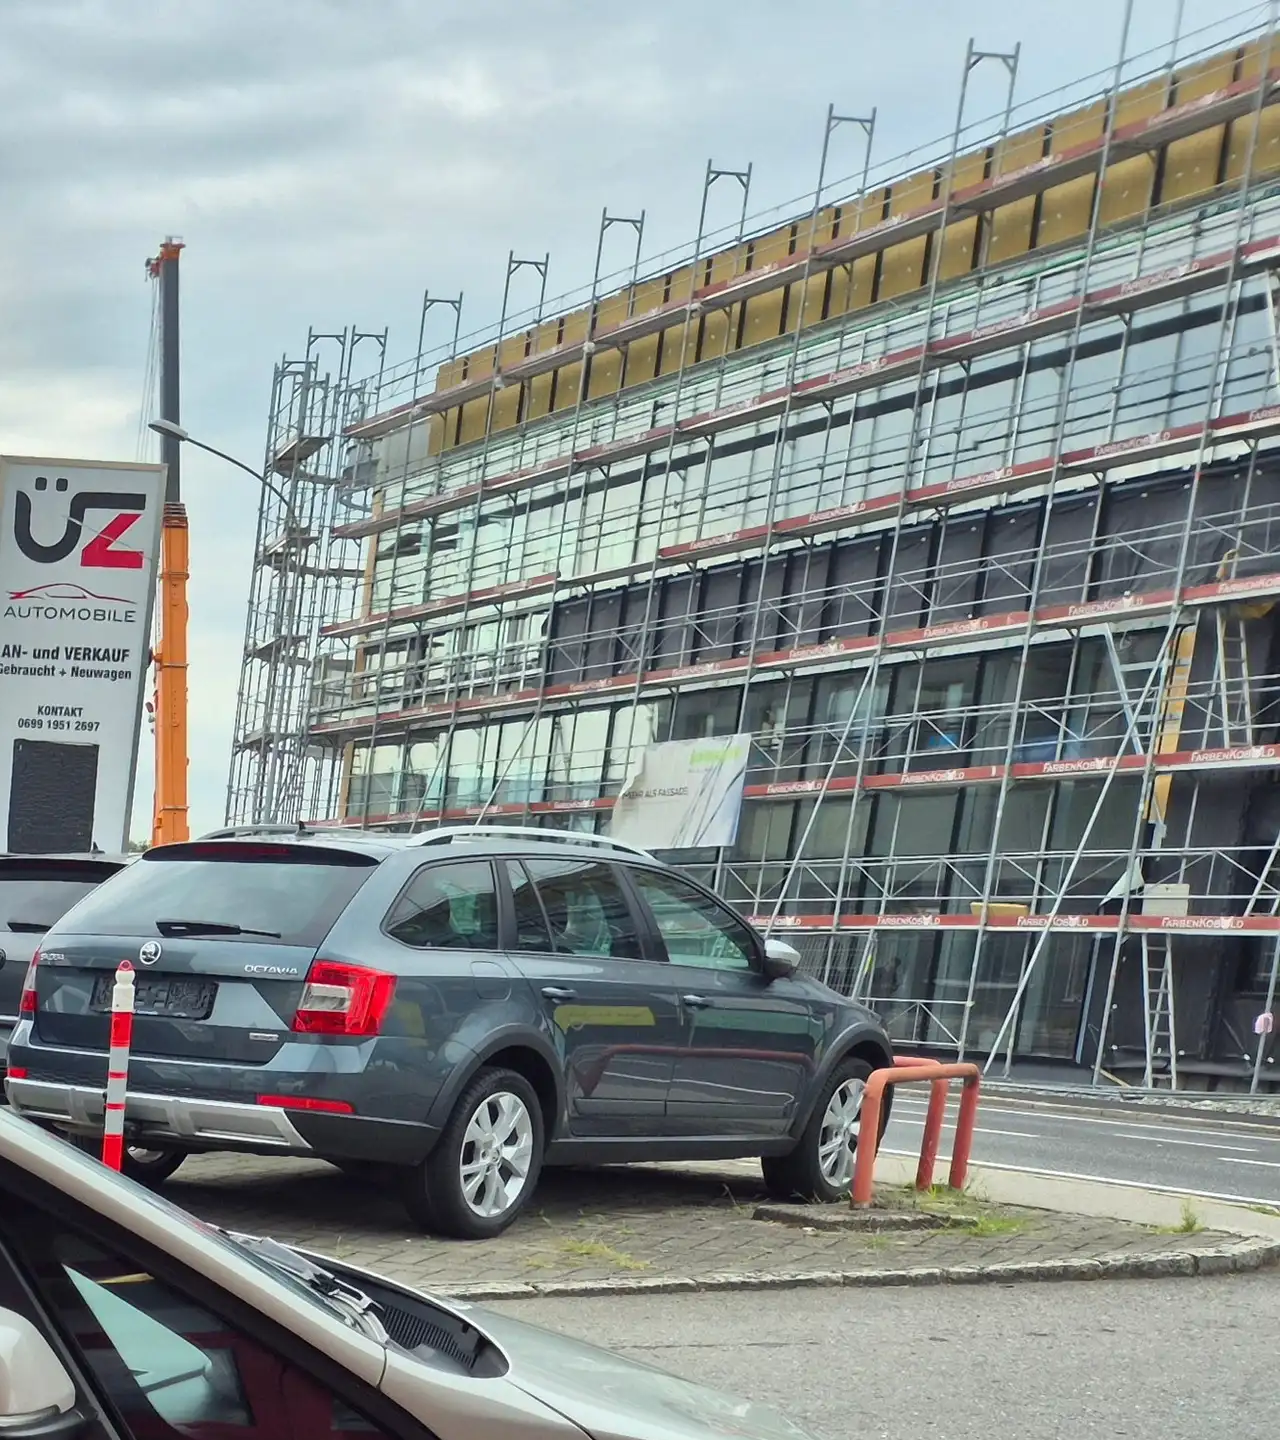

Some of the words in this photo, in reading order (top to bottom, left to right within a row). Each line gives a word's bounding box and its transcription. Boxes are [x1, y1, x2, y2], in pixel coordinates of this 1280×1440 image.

[3, 605, 137, 623] AUTOMOBILE
[0, 644, 28, 659] AN-
[32, 646, 60, 661] und
[64, 646, 130, 663] VERKAUF
[70, 666, 131, 681] Neuwagen
[37, 705, 83, 718] KONTAKT
[17, 718, 43, 729] 0699
[47, 720, 71, 730] 1951
[244, 964, 298, 974] OCTAVIA
